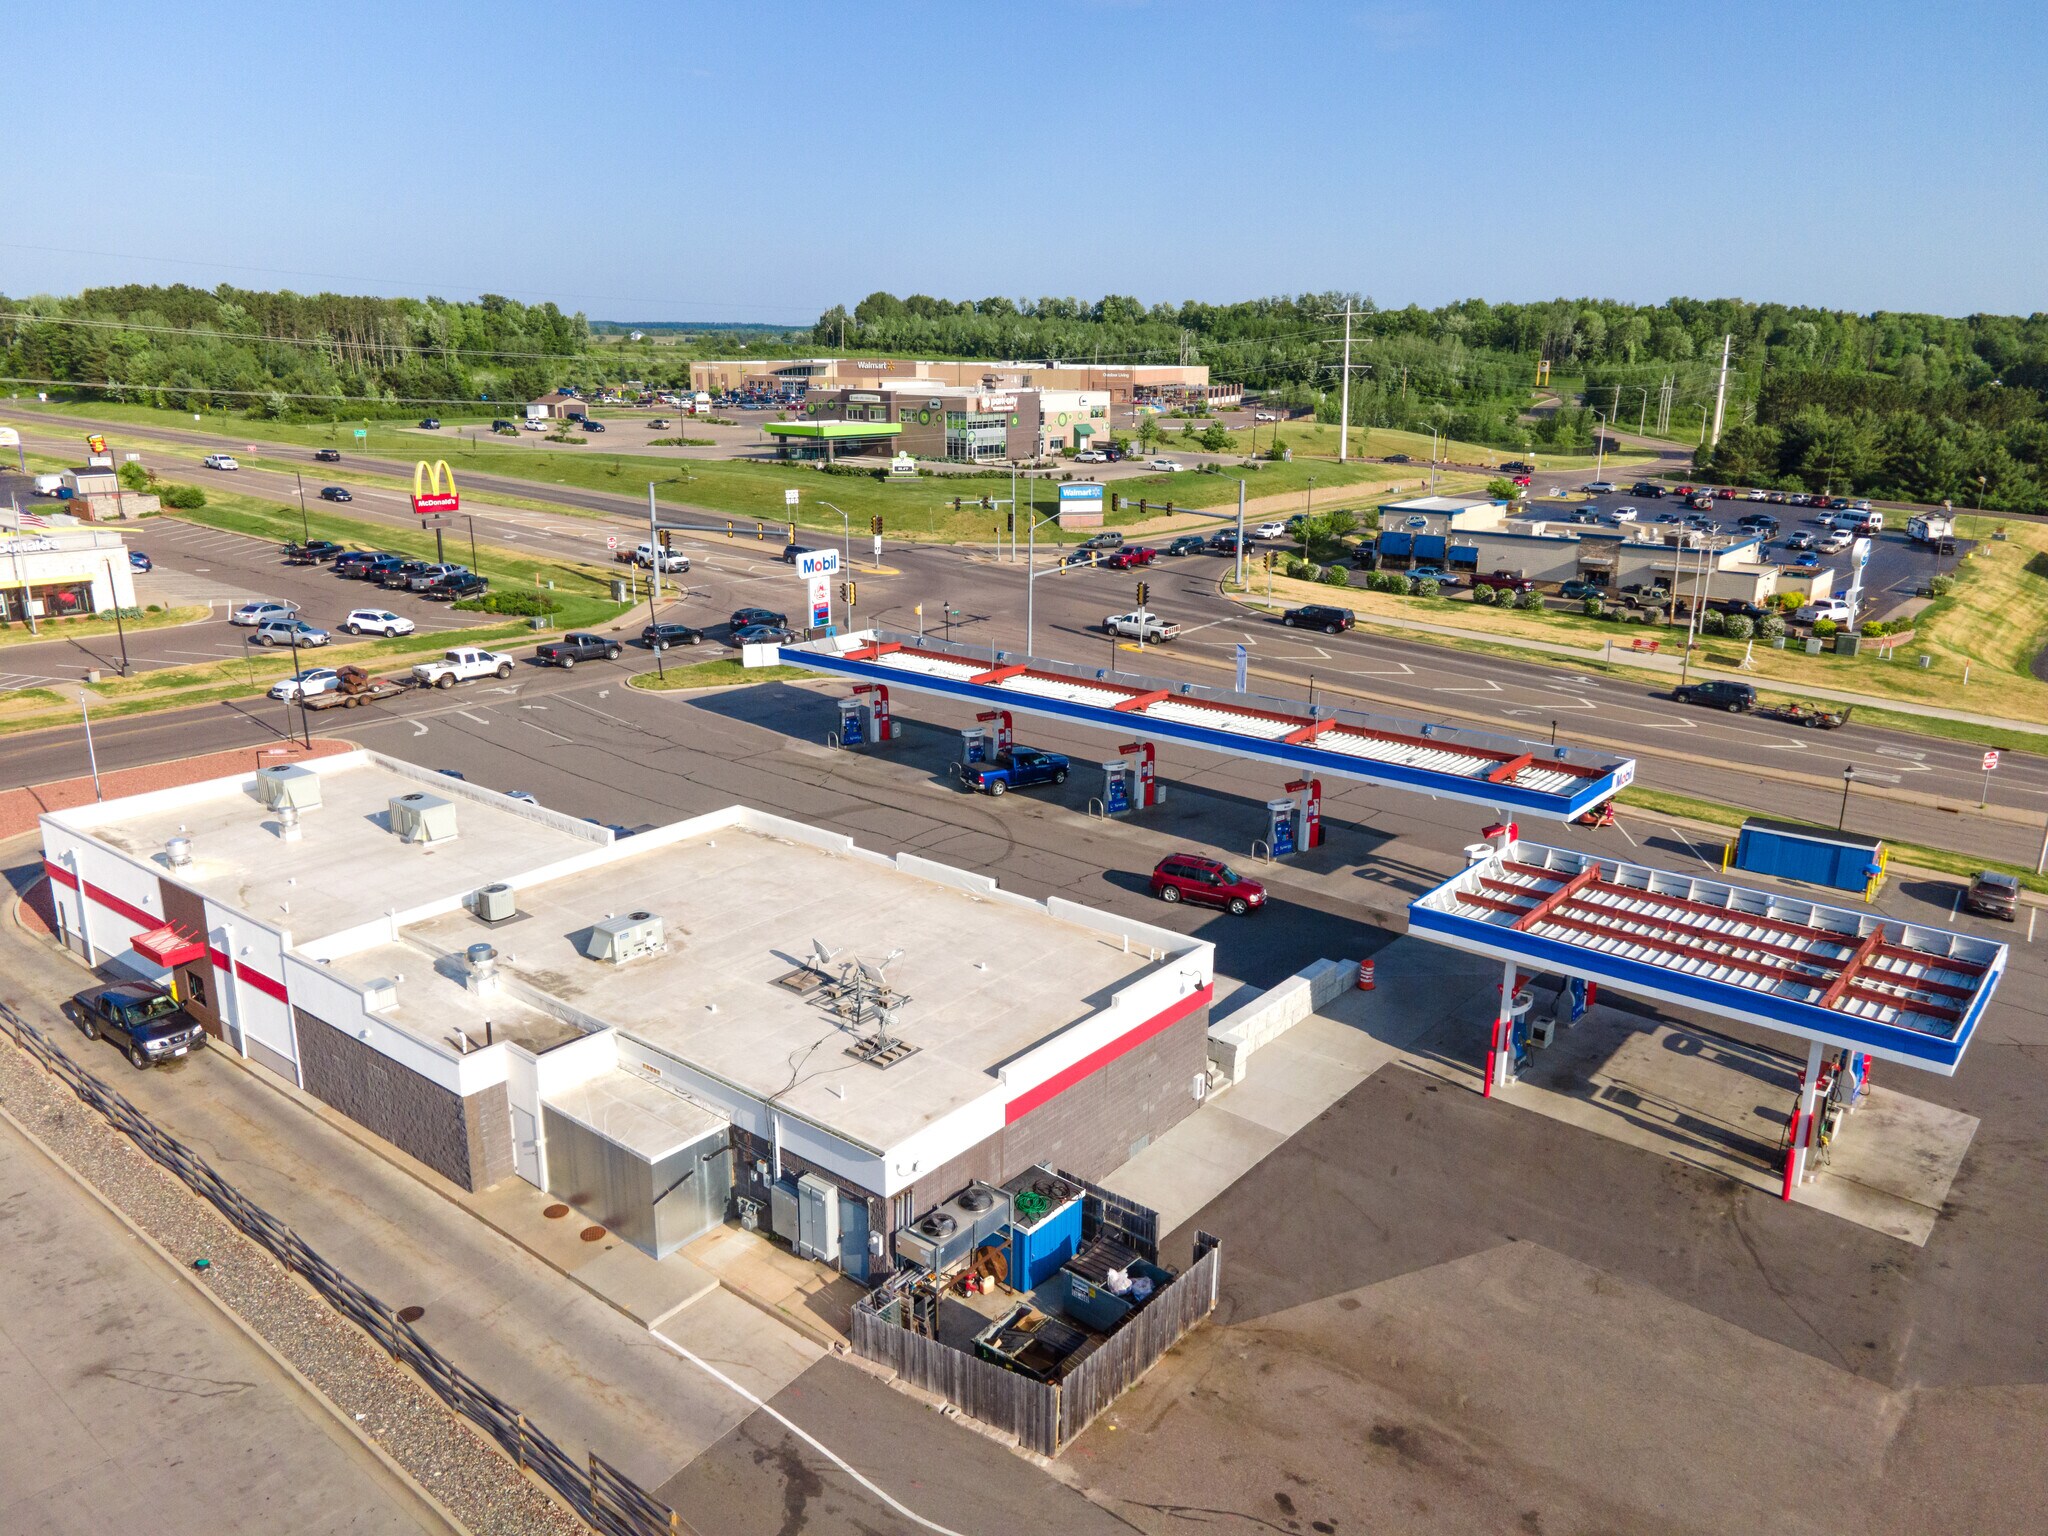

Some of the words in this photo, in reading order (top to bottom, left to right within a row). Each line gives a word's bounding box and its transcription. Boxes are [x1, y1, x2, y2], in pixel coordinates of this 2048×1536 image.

[857, 361, 887, 370] Walmart
[1062, 488, 1092, 497] Walmart
[418, 498, 456, 507] McDonald's
[803, 554, 836, 574] Mobil
[1615, 766, 1633, 789] Mobil
